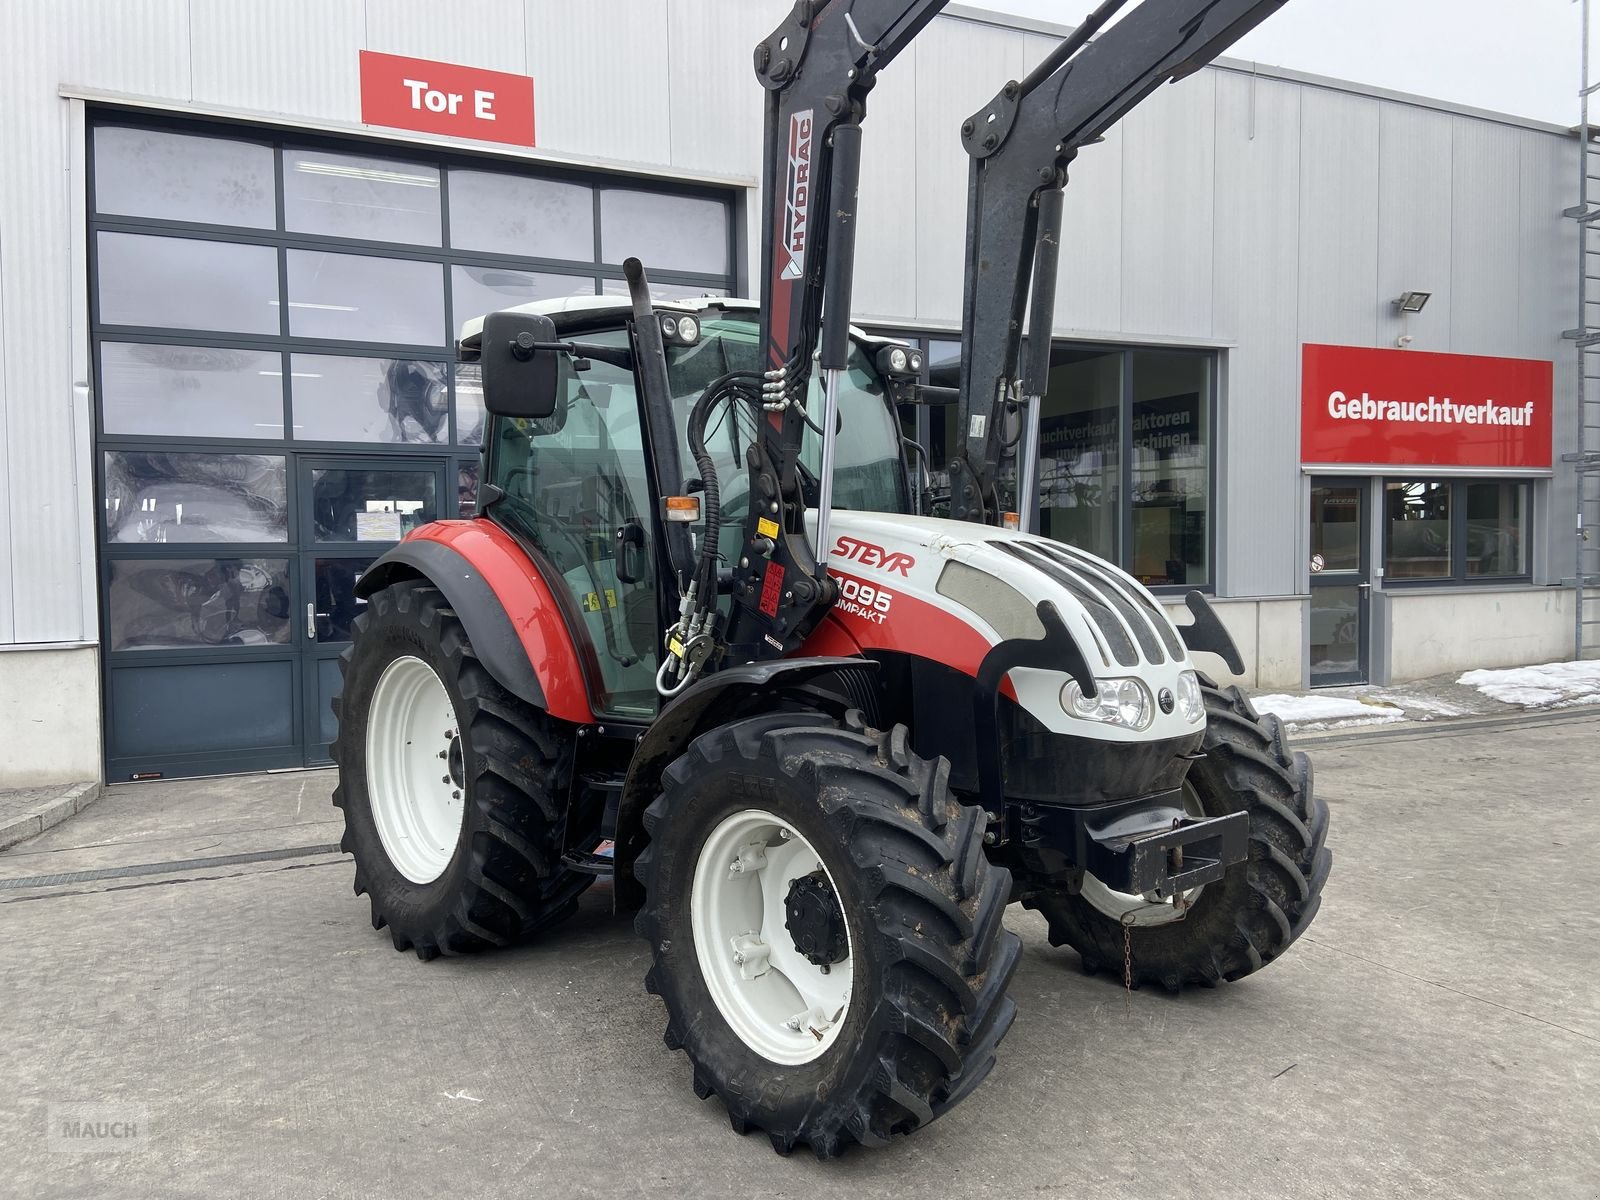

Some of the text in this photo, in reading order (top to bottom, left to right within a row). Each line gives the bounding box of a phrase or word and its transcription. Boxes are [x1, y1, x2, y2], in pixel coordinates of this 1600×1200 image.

[403, 78, 496, 121] Tor E
[792, 118, 811, 252] HYDRAC
[1328, 390, 1534, 426] Gebrauchtverkauf
[830, 536, 915, 577] STEYR
